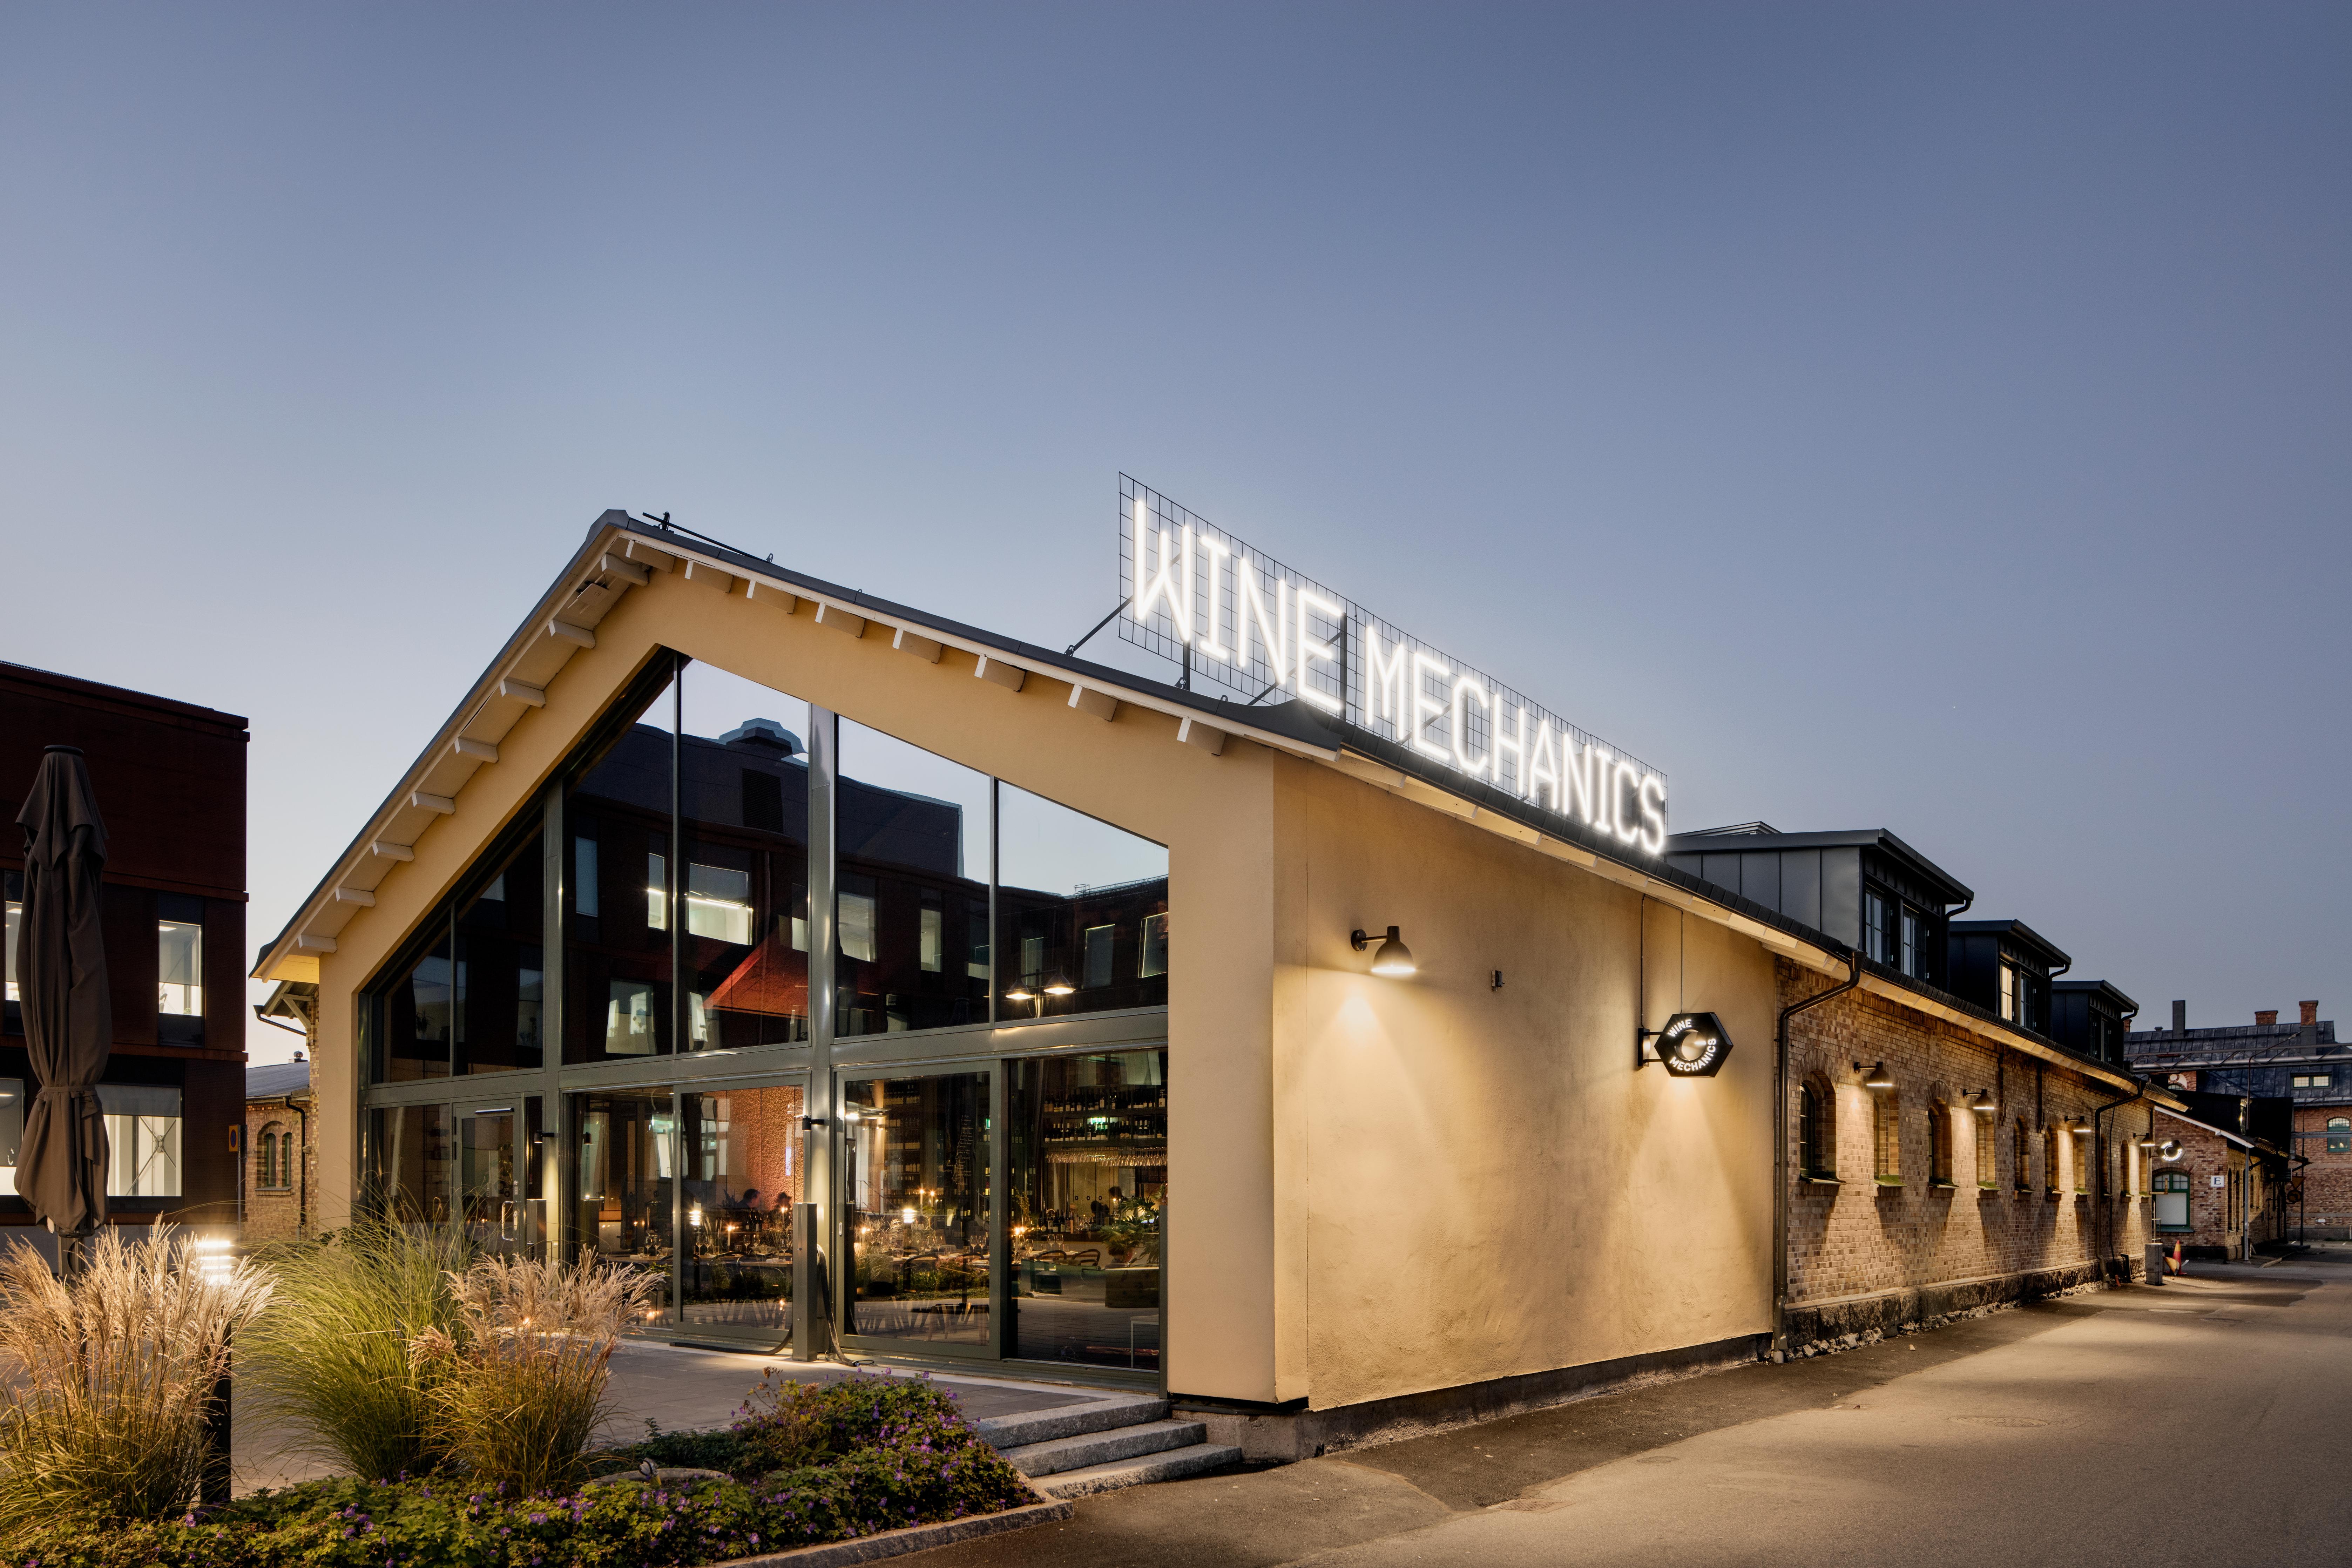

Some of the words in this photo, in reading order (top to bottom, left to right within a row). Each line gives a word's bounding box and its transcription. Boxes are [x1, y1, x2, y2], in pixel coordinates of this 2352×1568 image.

[1133, 500, 1343, 711] WINE
[1364, 626, 1667, 856] MECHANICS
[1668, 1019, 1692, 1037] WINE
[1669, 1038, 1716, 1072] MECHANICS
